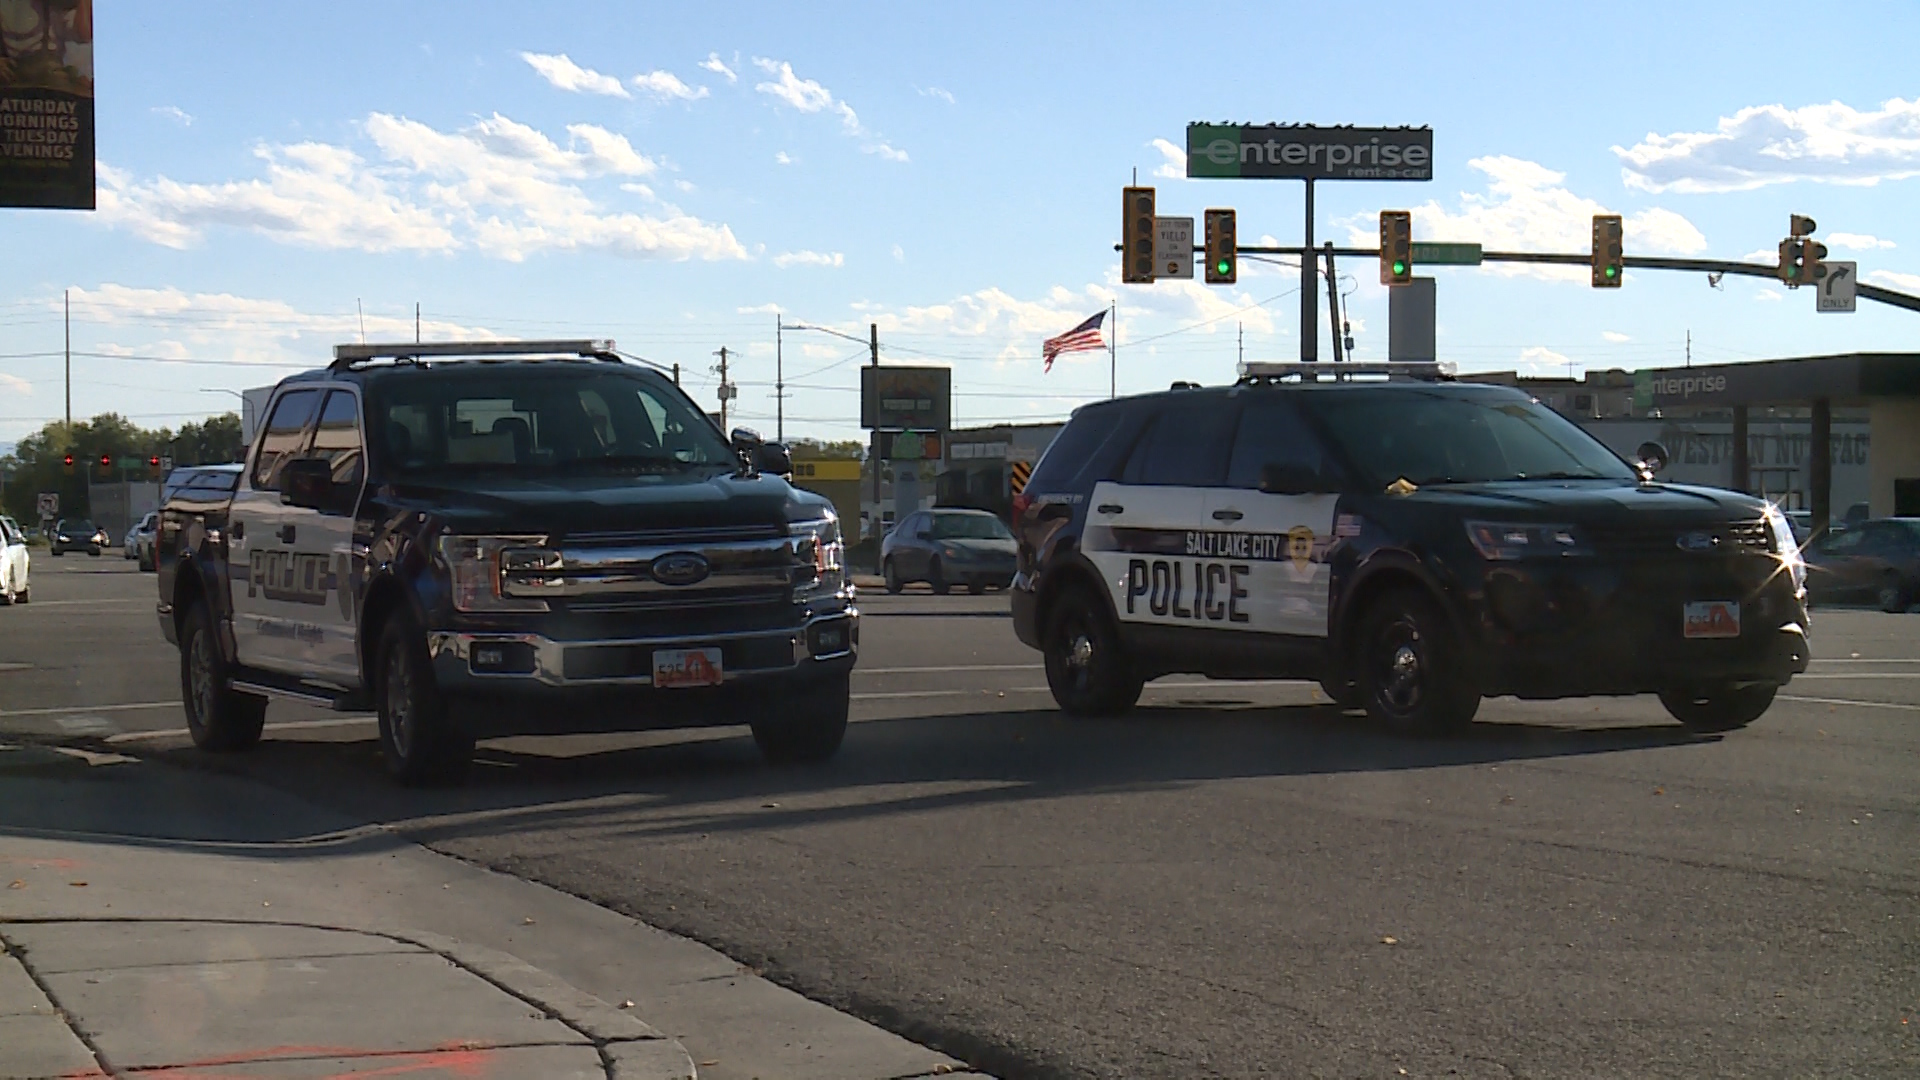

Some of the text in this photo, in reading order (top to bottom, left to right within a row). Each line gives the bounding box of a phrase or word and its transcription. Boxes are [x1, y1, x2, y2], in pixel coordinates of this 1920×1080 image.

[4, 129, 79, 145] TUESDAY
[0, 143, 74, 160] VENINGS
[1193, 137, 1429, 172] enterprise
[1347, 166, 1428, 178] rent-a-car
[1161, 231, 1187, 242] YIELD
[1823, 299, 1849, 308] ONLY
[1634, 371, 1726, 399] enterprise
[1186, 531, 1280, 559] SALT LAKE CITY
[249, 550, 330, 605] POLICE
[1127, 558, 1250, 623] POLICE
